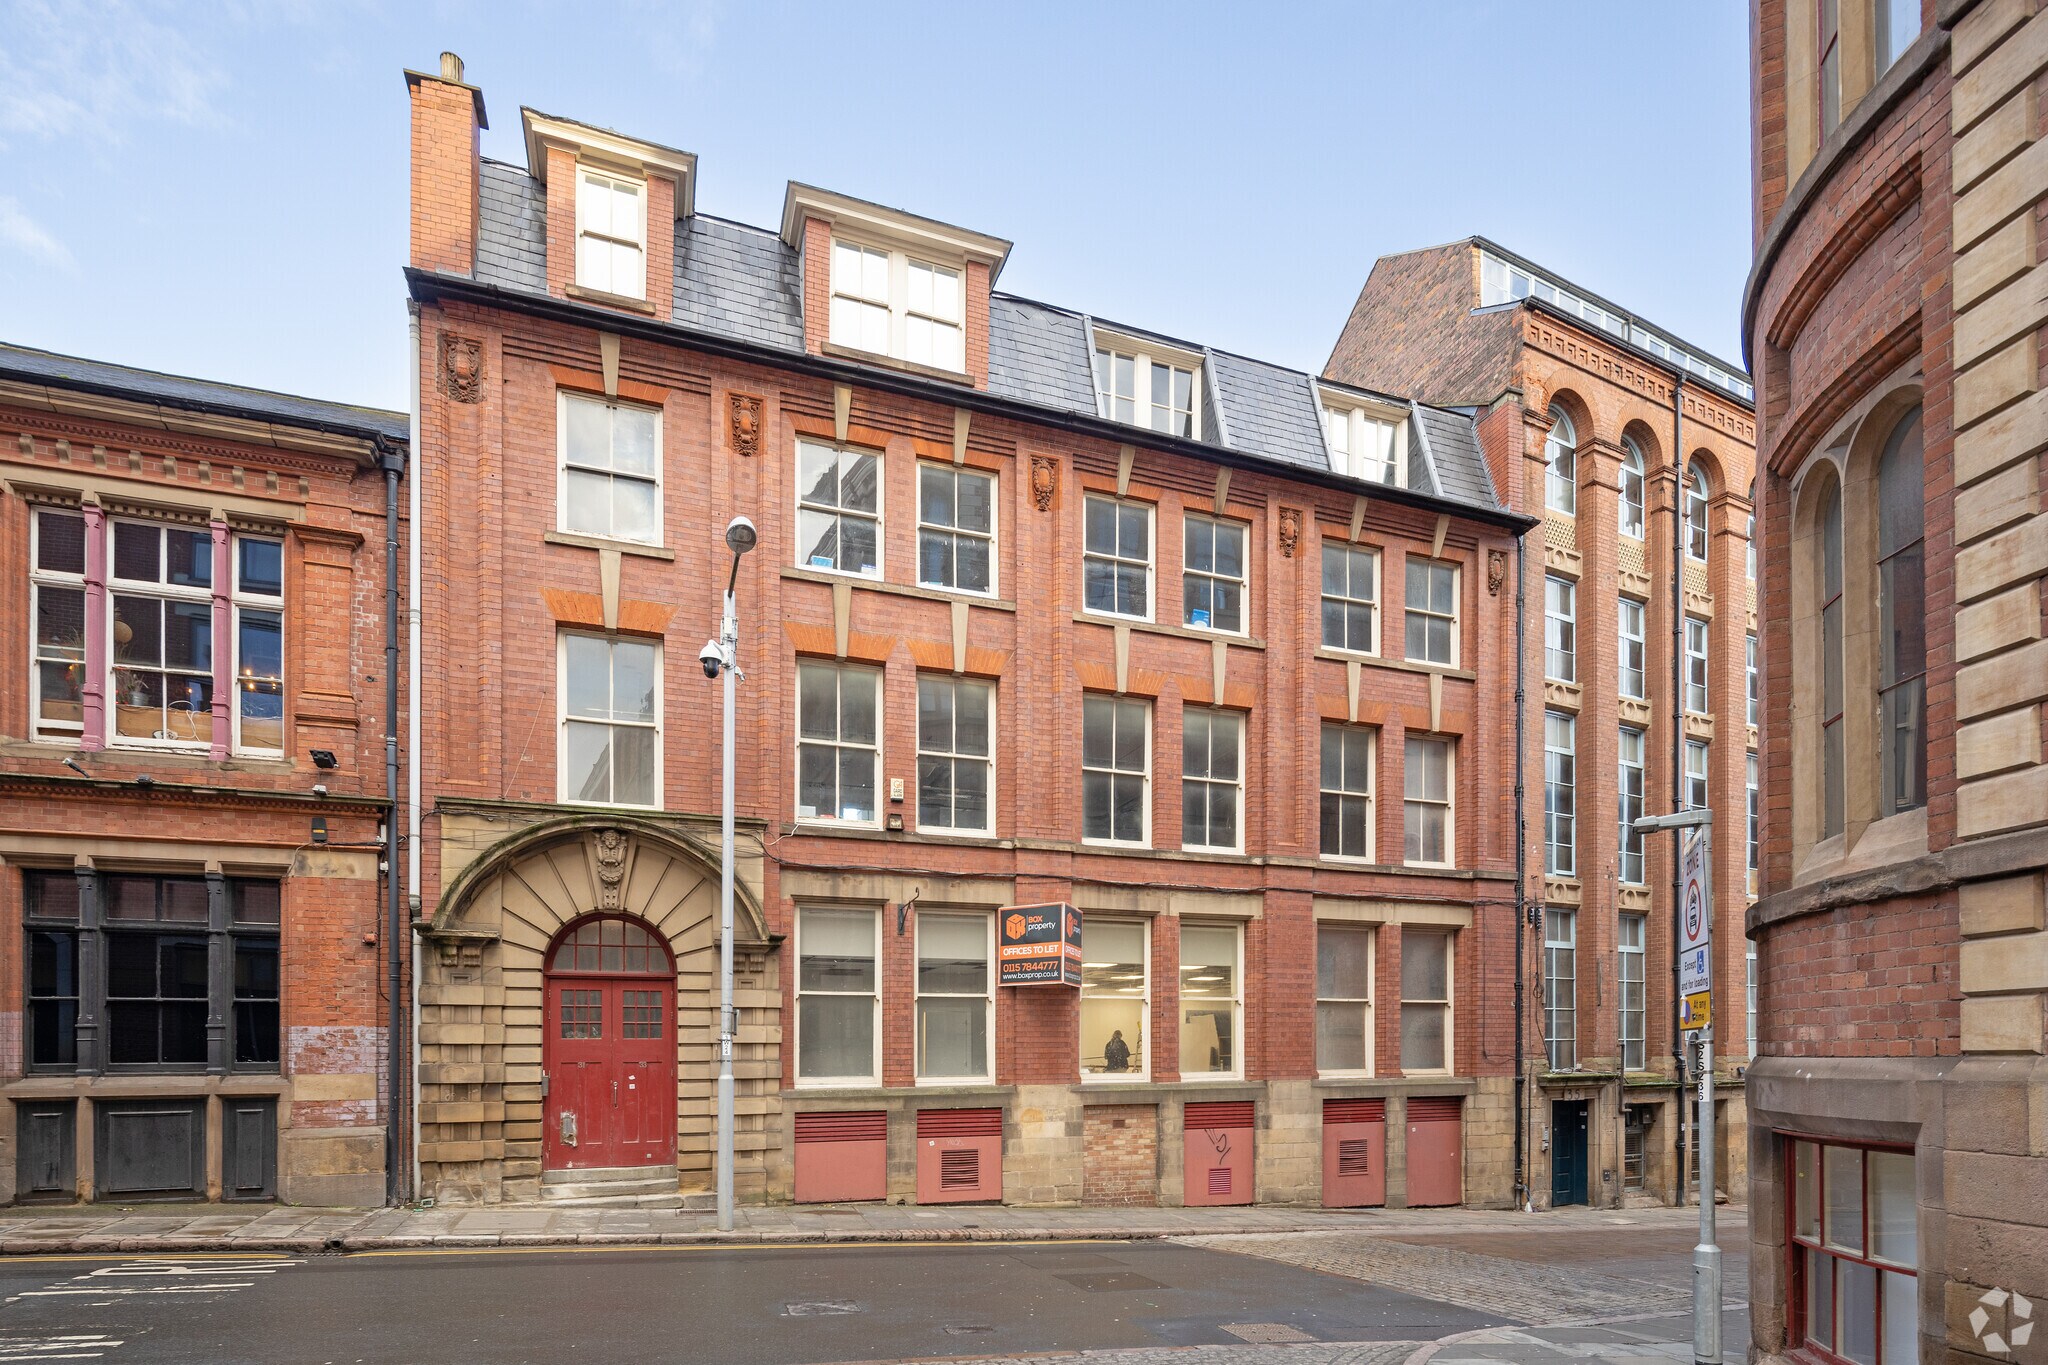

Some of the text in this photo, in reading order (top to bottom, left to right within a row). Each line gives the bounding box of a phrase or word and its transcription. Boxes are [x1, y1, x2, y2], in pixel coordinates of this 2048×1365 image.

[1687, 852, 1699, 876] ZONE
[1028, 915, 1043, 923] BOX
[1028, 922, 1055, 930] property
[1003, 946, 1032, 956] OFFICES
[1033, 945, 1043, 953] TO
[1044, 944, 1058, 952] LET
[1003, 963, 1020, 972] 0115
[1021, 961, 1058, 971] 7844777
[1684, 960, 1696, 971] Except
[1002, 971, 1058, 979] www.boxprop.co.uk
[1694, 976, 1708, 987] loading
[577, 1061, 586, 1069] 31
[1567, 1089, 1580, 1100] 35
